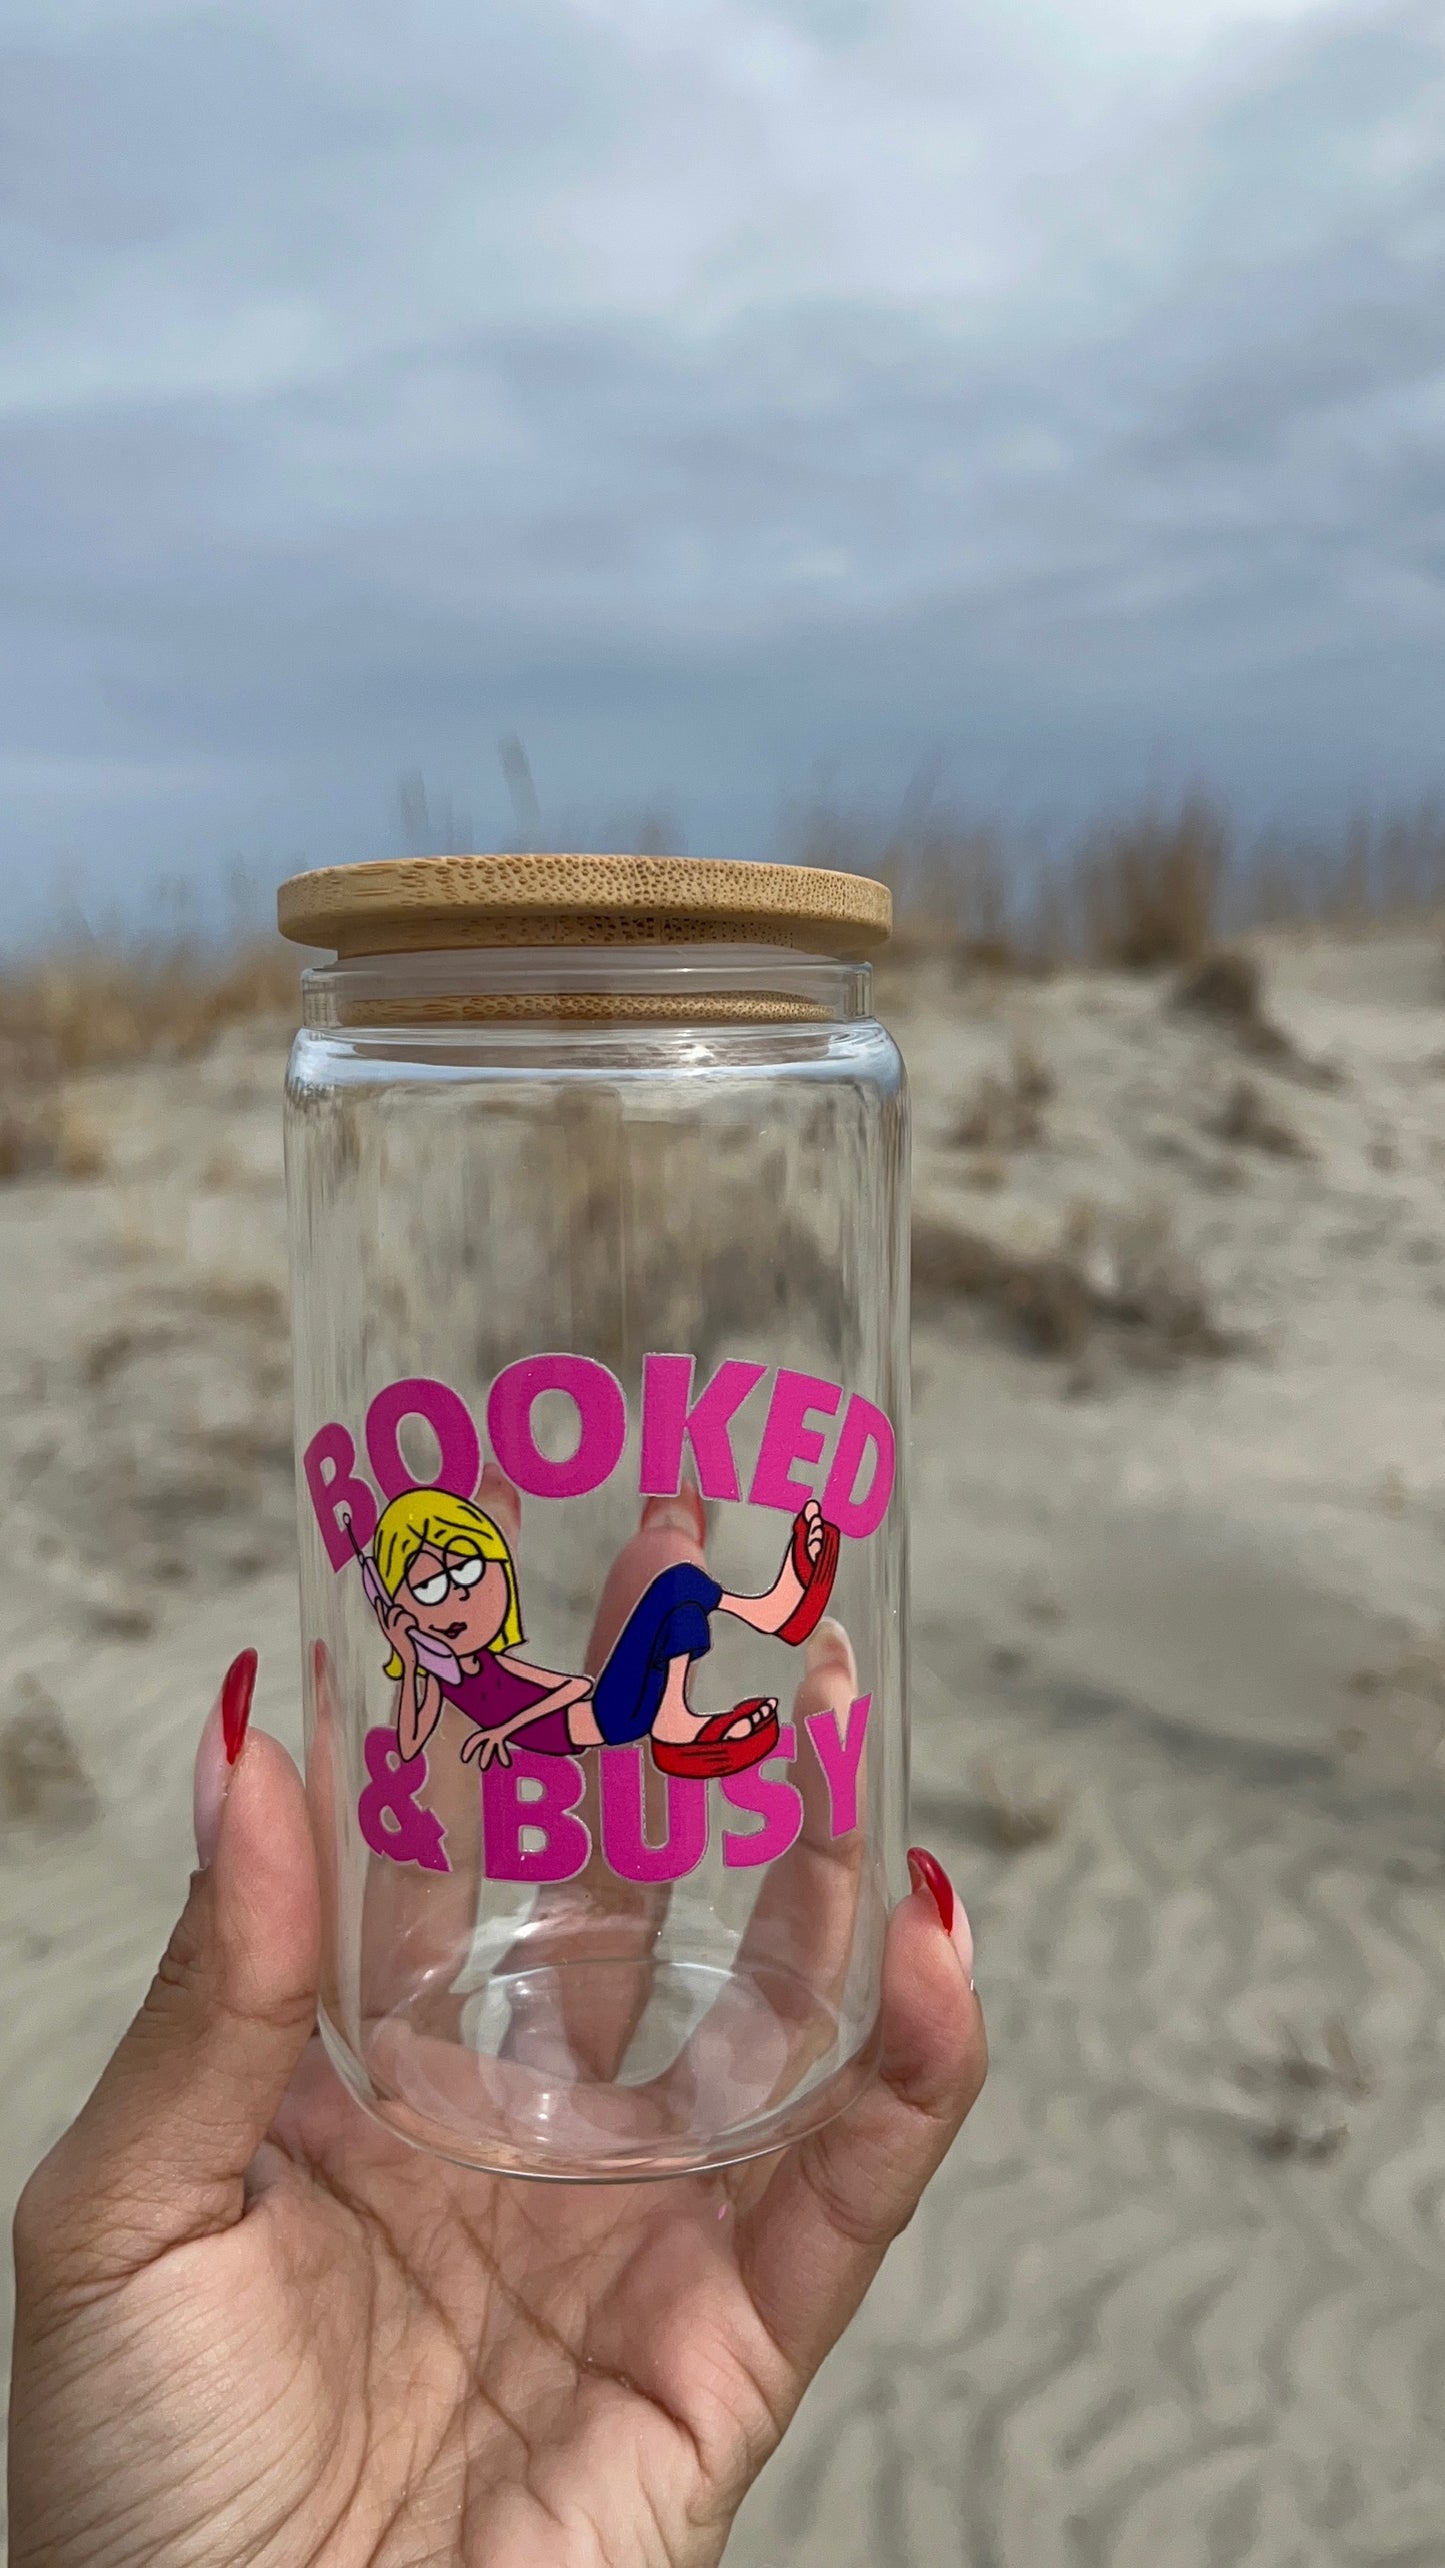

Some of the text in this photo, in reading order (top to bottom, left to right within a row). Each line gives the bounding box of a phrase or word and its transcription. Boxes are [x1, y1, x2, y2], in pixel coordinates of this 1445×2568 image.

[303, 1353, 896, 1573] BOOKED
[357, 1693, 873, 1884] & BUSY
